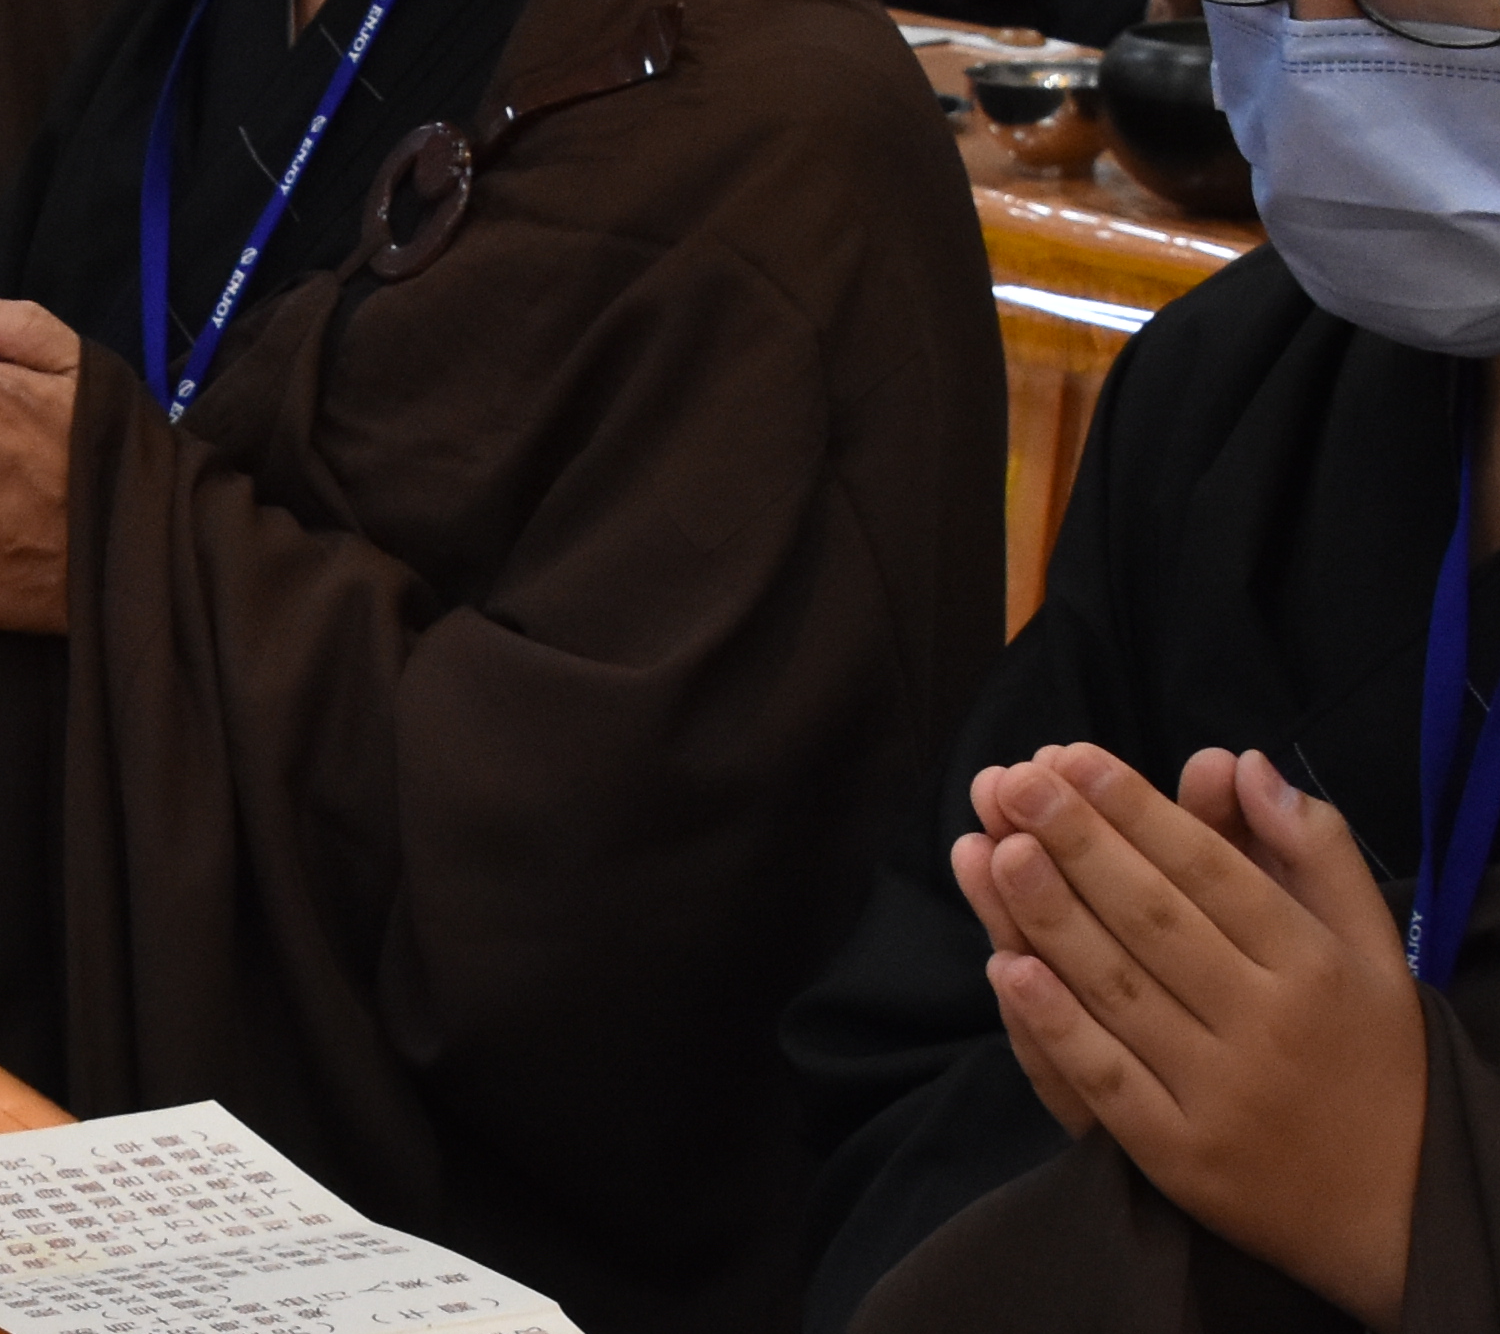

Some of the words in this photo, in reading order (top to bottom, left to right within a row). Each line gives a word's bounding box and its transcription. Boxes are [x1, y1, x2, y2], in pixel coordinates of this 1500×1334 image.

[348, 4, 384, 64] ENJOY
[279, 137, 313, 196] ENJOY
[213, 269, 247, 329] ENJOY
